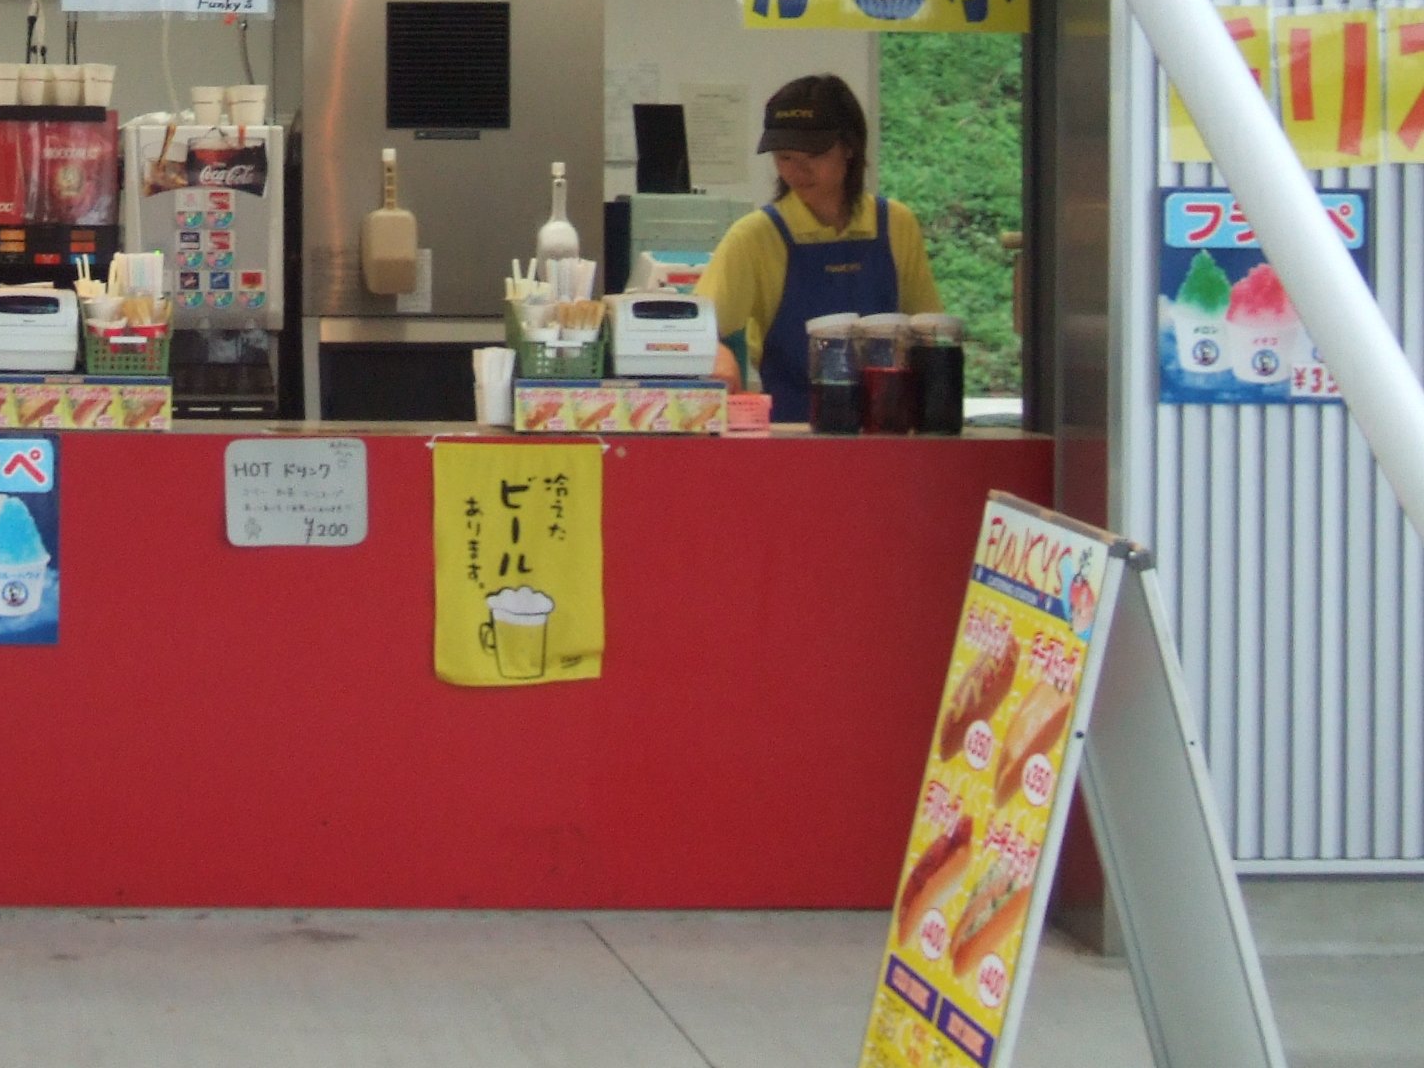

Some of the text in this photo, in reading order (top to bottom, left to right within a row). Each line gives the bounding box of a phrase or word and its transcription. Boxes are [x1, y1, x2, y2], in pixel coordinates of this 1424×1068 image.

[1184, 202, 1355, 243] フラペ
[233, 461, 331, 480] HOT ドリンク
[498, 476, 536, 578] ビール
[543, 473, 570, 542] 冷えた
